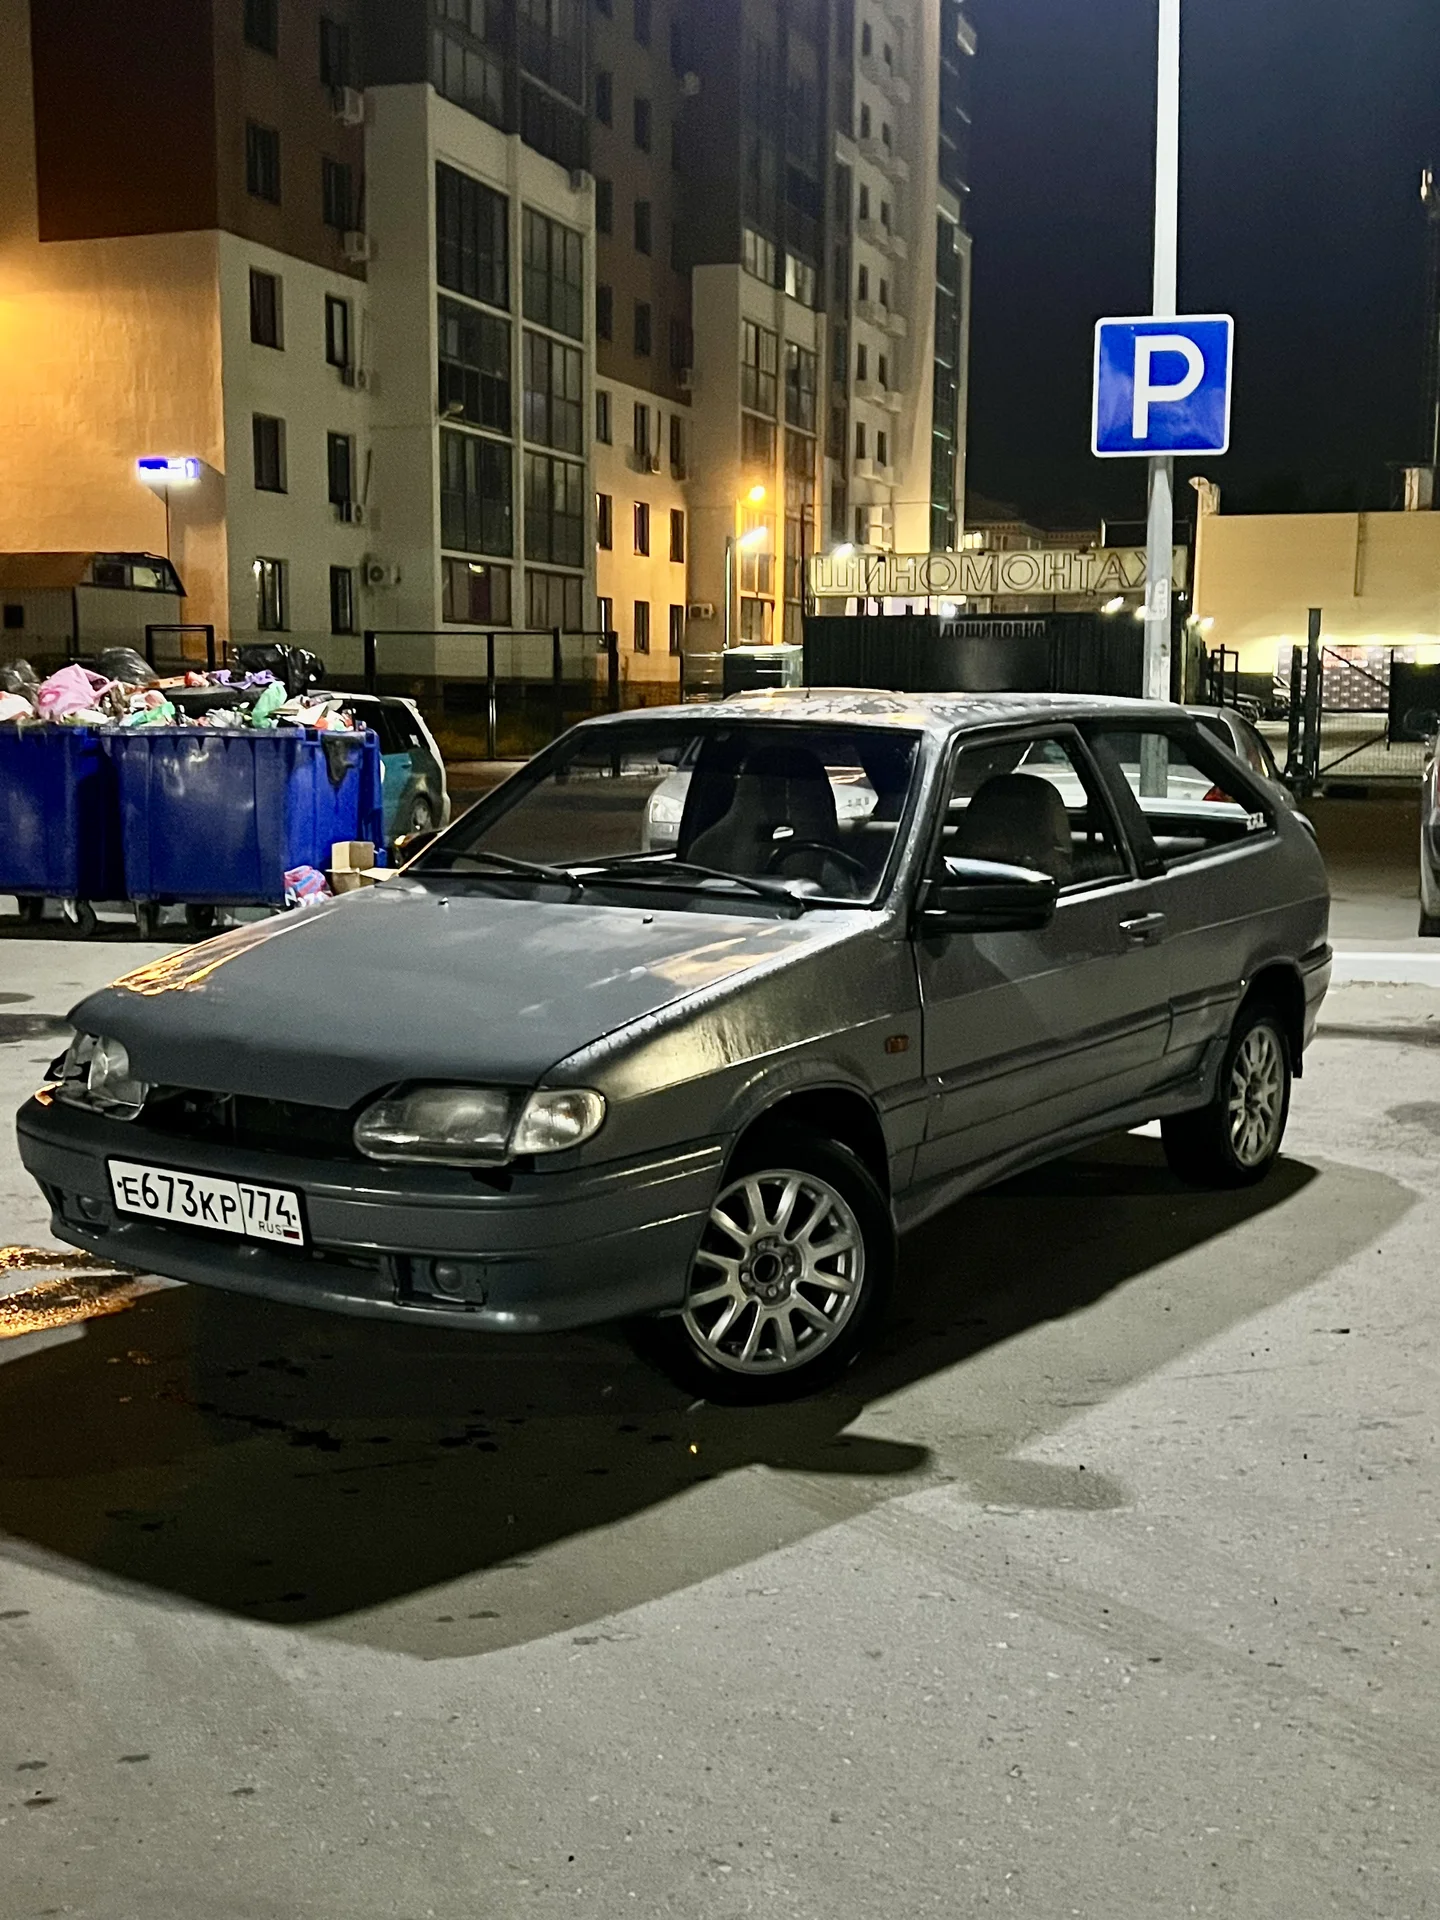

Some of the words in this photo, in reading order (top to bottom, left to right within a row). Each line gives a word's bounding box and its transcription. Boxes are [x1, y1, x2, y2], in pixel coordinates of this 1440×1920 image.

[1132, 334, 1205, 439] P
[121, 1172, 237, 1225] Е673КР
[241, 1187, 293, 1226] 774
[258, 1220, 283, 1236] RUS
